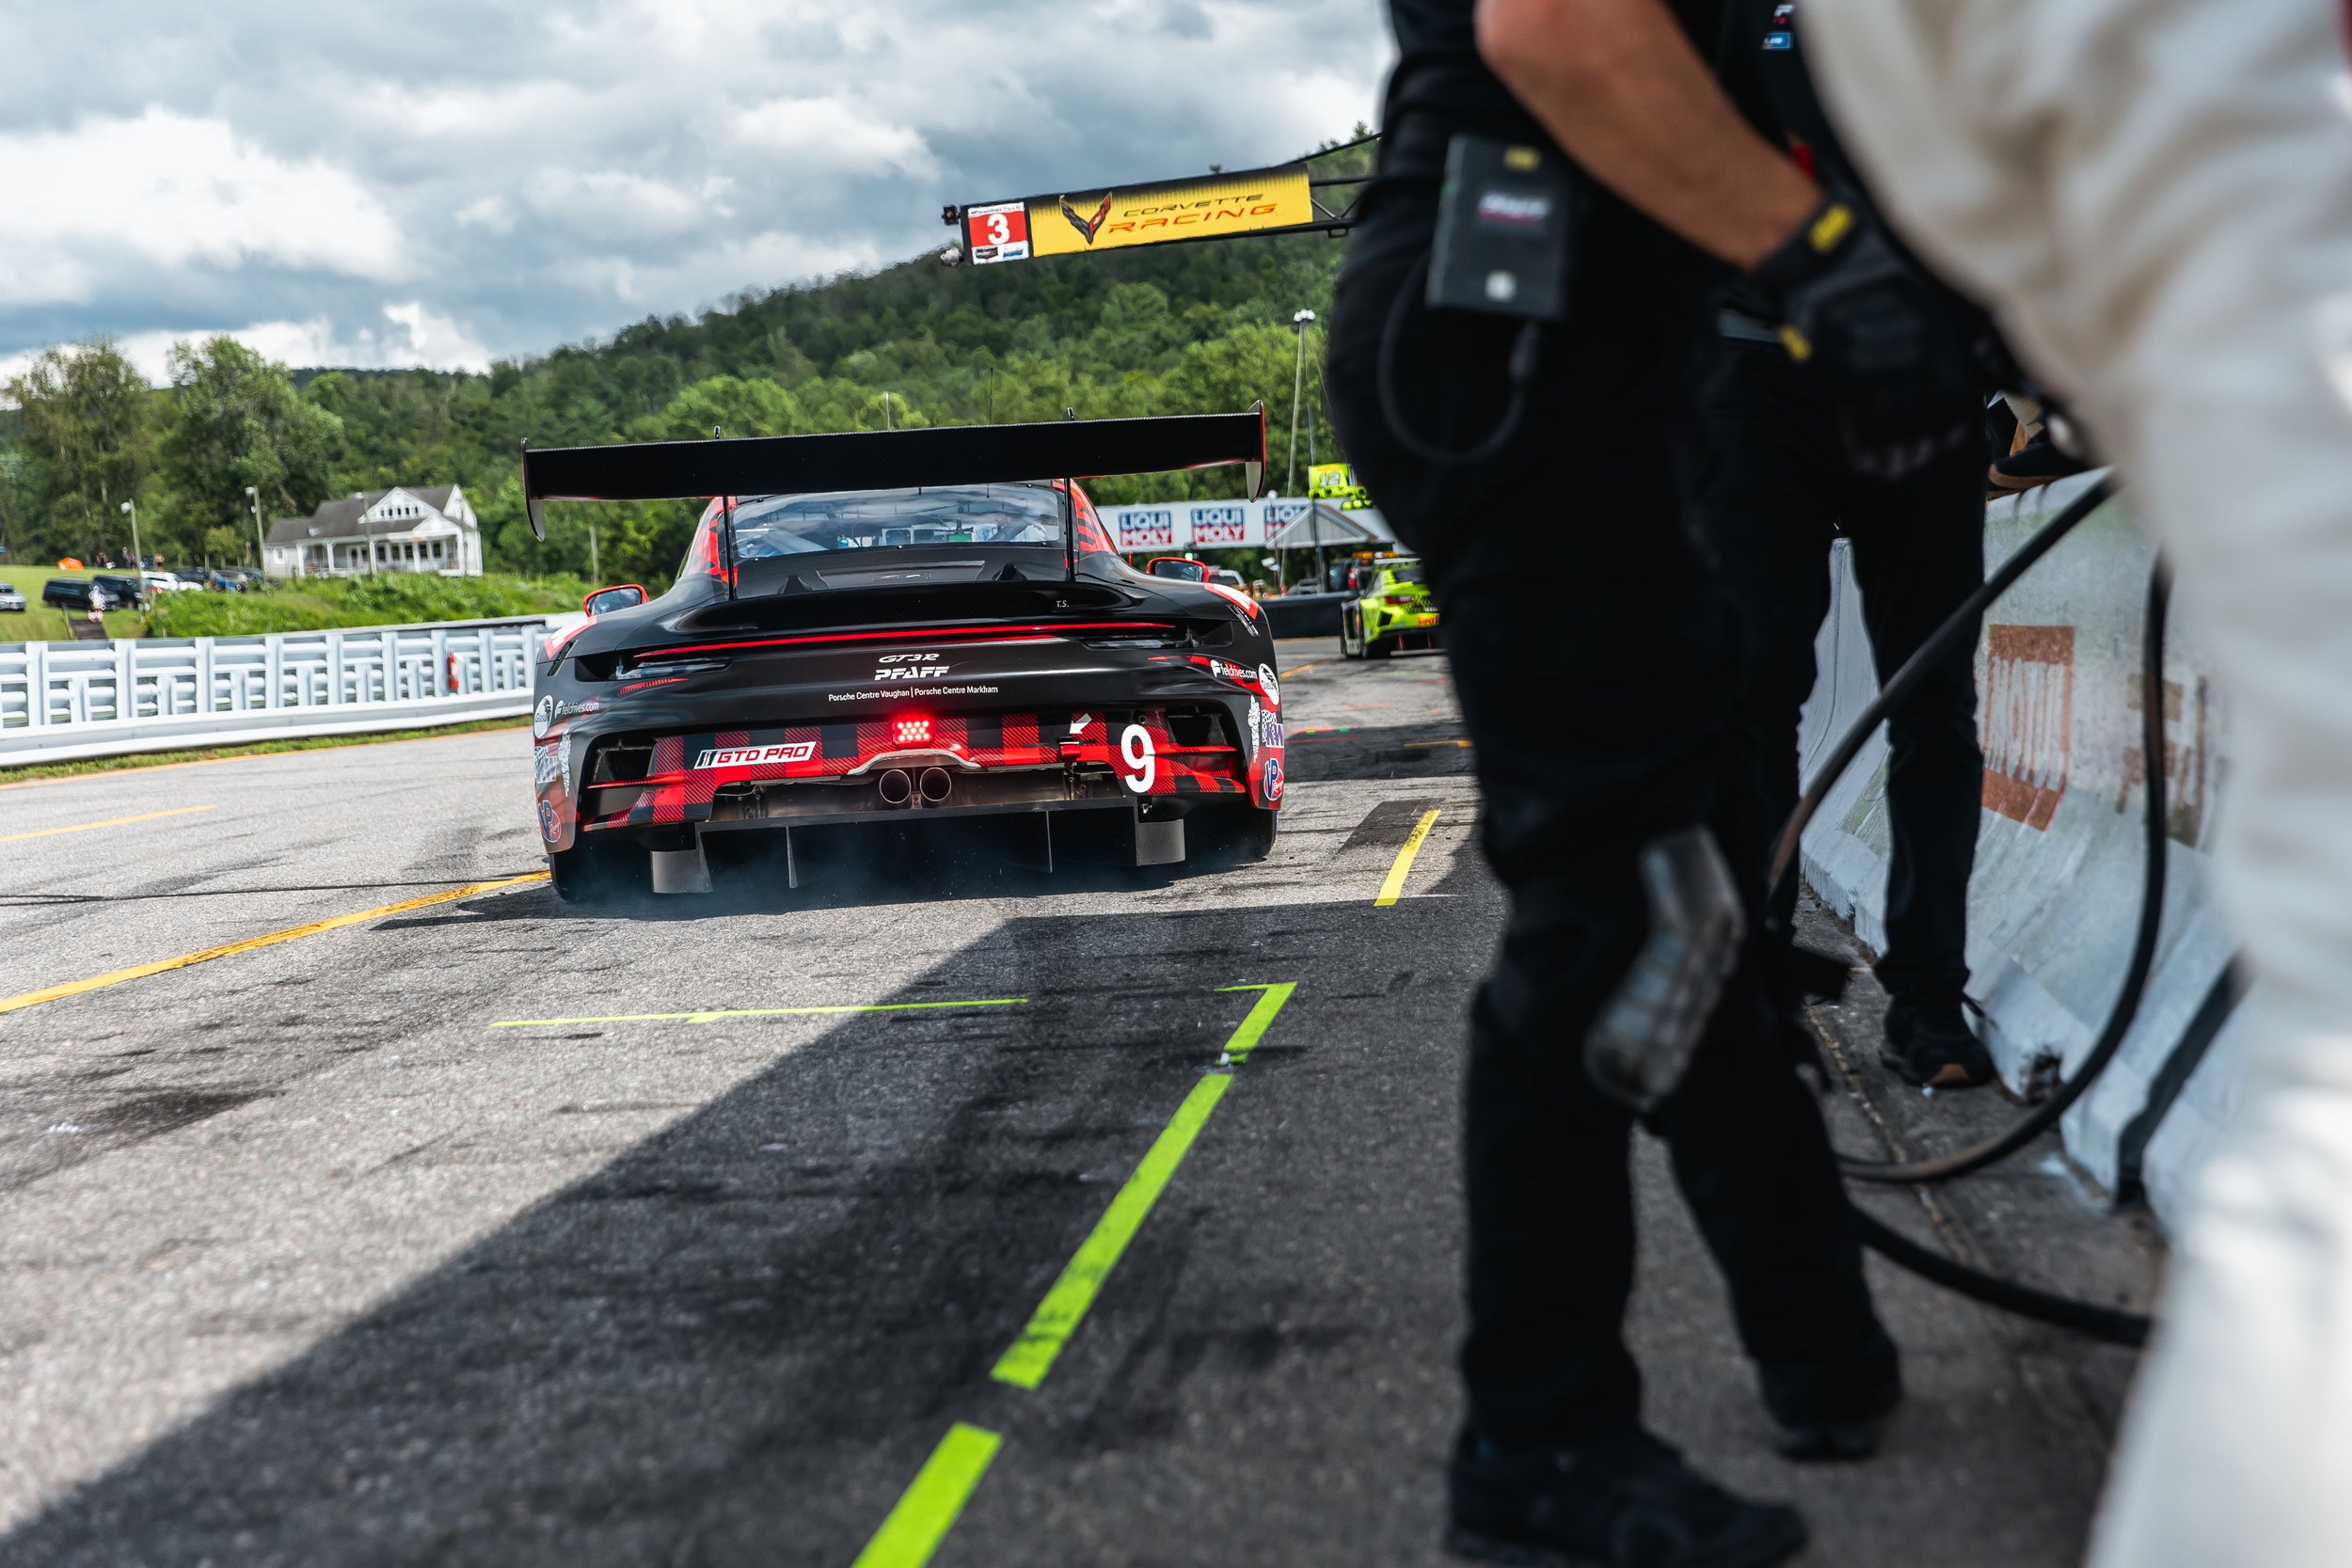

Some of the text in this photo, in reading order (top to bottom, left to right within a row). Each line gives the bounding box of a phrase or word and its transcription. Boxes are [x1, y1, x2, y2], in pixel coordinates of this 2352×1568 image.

[1123, 194, 1263, 217] CORVETTE
[1108, 203, 1278, 233] RACING
[987, 214, 1010, 245] 3
[1120, 512, 1171, 530] LIQUI
[1192, 508, 1244, 527] LIQUI
[1264, 506, 1306, 525] LIQ
[1120, 529, 1172, 546] MOLY
[1193, 525, 1244, 543] MOLY
[874, 666, 949, 681] PFAFF
[828, 693, 855, 702] Porsche
[856, 691, 880, 700] Centre
[880, 689, 910, 698] Vaughan
[914, 688, 942, 696] Porsche
[943, 686, 966, 694] Centre
[966, 685, 998, 694] Markham
[1266, 723, 1284, 746] KW
[717, 746, 809, 764] GTD PRO
[1120, 723, 1156, 793] 9
[1264, 758, 1279, 800] VP
[538, 800, 553, 840] VP
